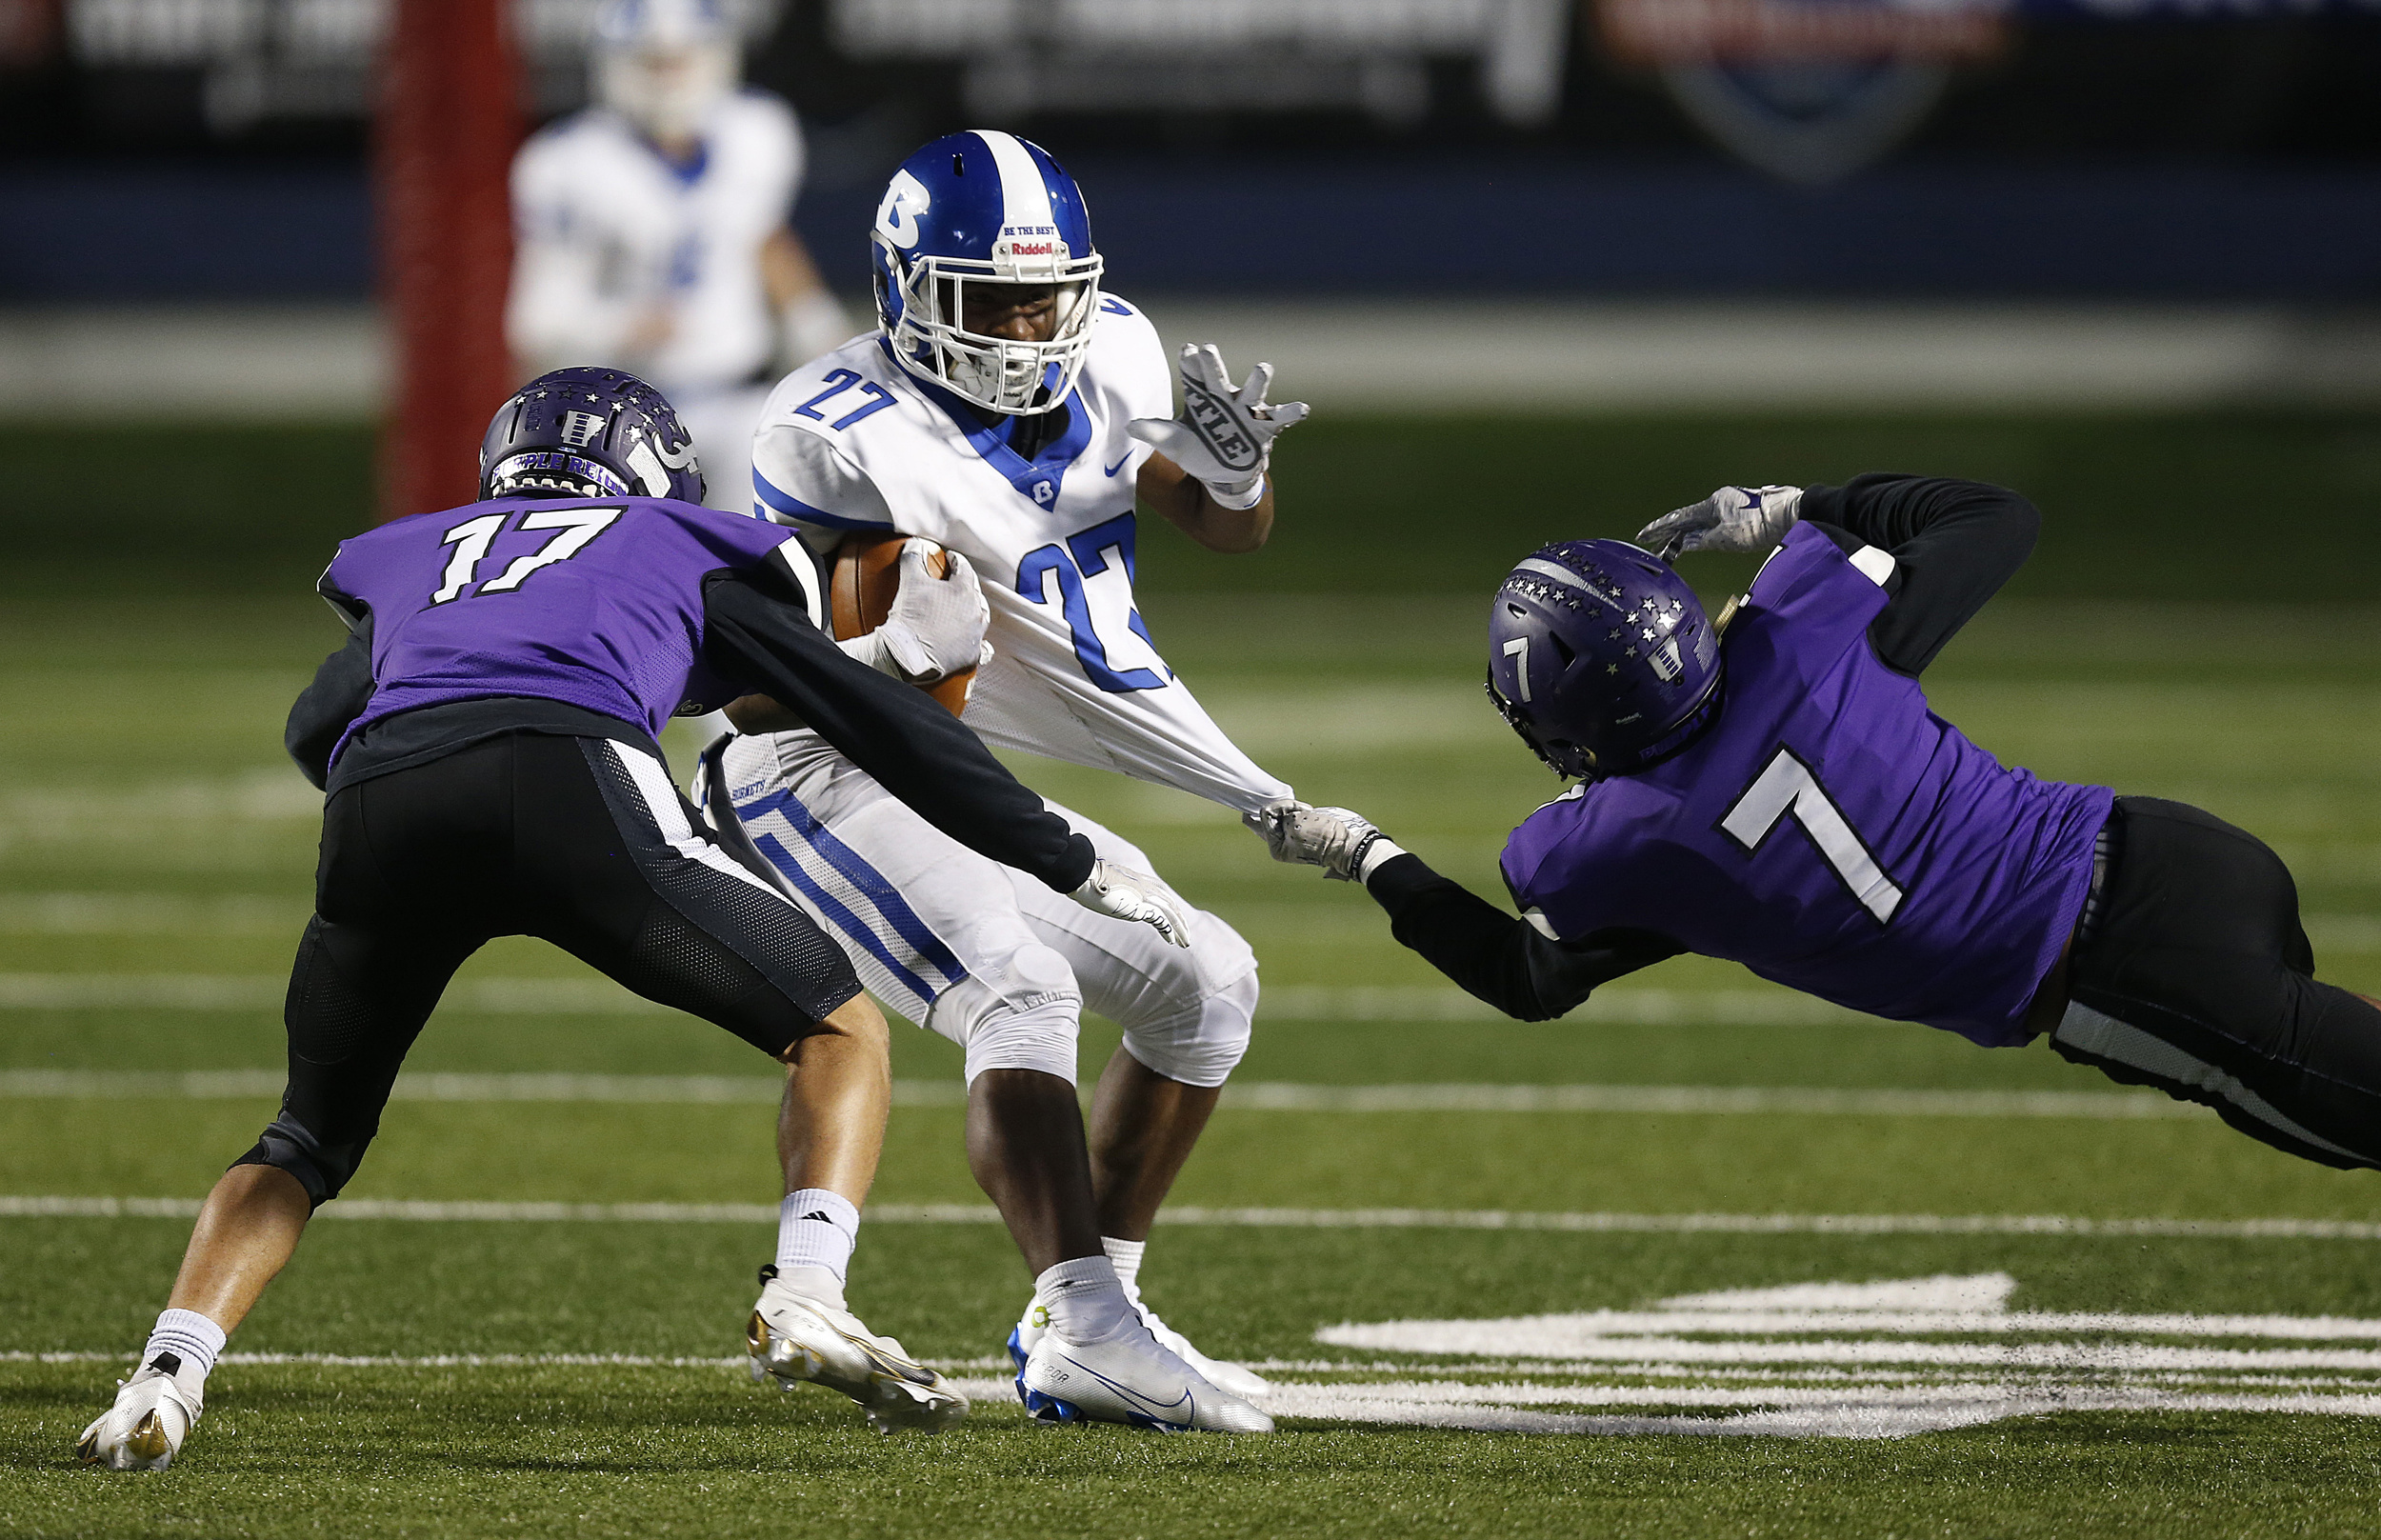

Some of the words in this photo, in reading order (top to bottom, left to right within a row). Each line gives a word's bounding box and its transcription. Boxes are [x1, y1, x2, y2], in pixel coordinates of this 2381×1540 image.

[875, 168, 931, 250] B
[1004, 227, 1015, 236] BE
[1017, 227, 1034, 235] THE
[1035, 226, 1054, 235] BEST
[1011, 242, 1052, 255] Riddell
[792, 368, 899, 431] 27
[1032, 479, 1054, 504] B
[428, 505, 630, 607] 17
[1015, 510, 1174, 693] 27
[1503, 636, 1532, 703] 7
[1717, 740, 1905, 929] 7
